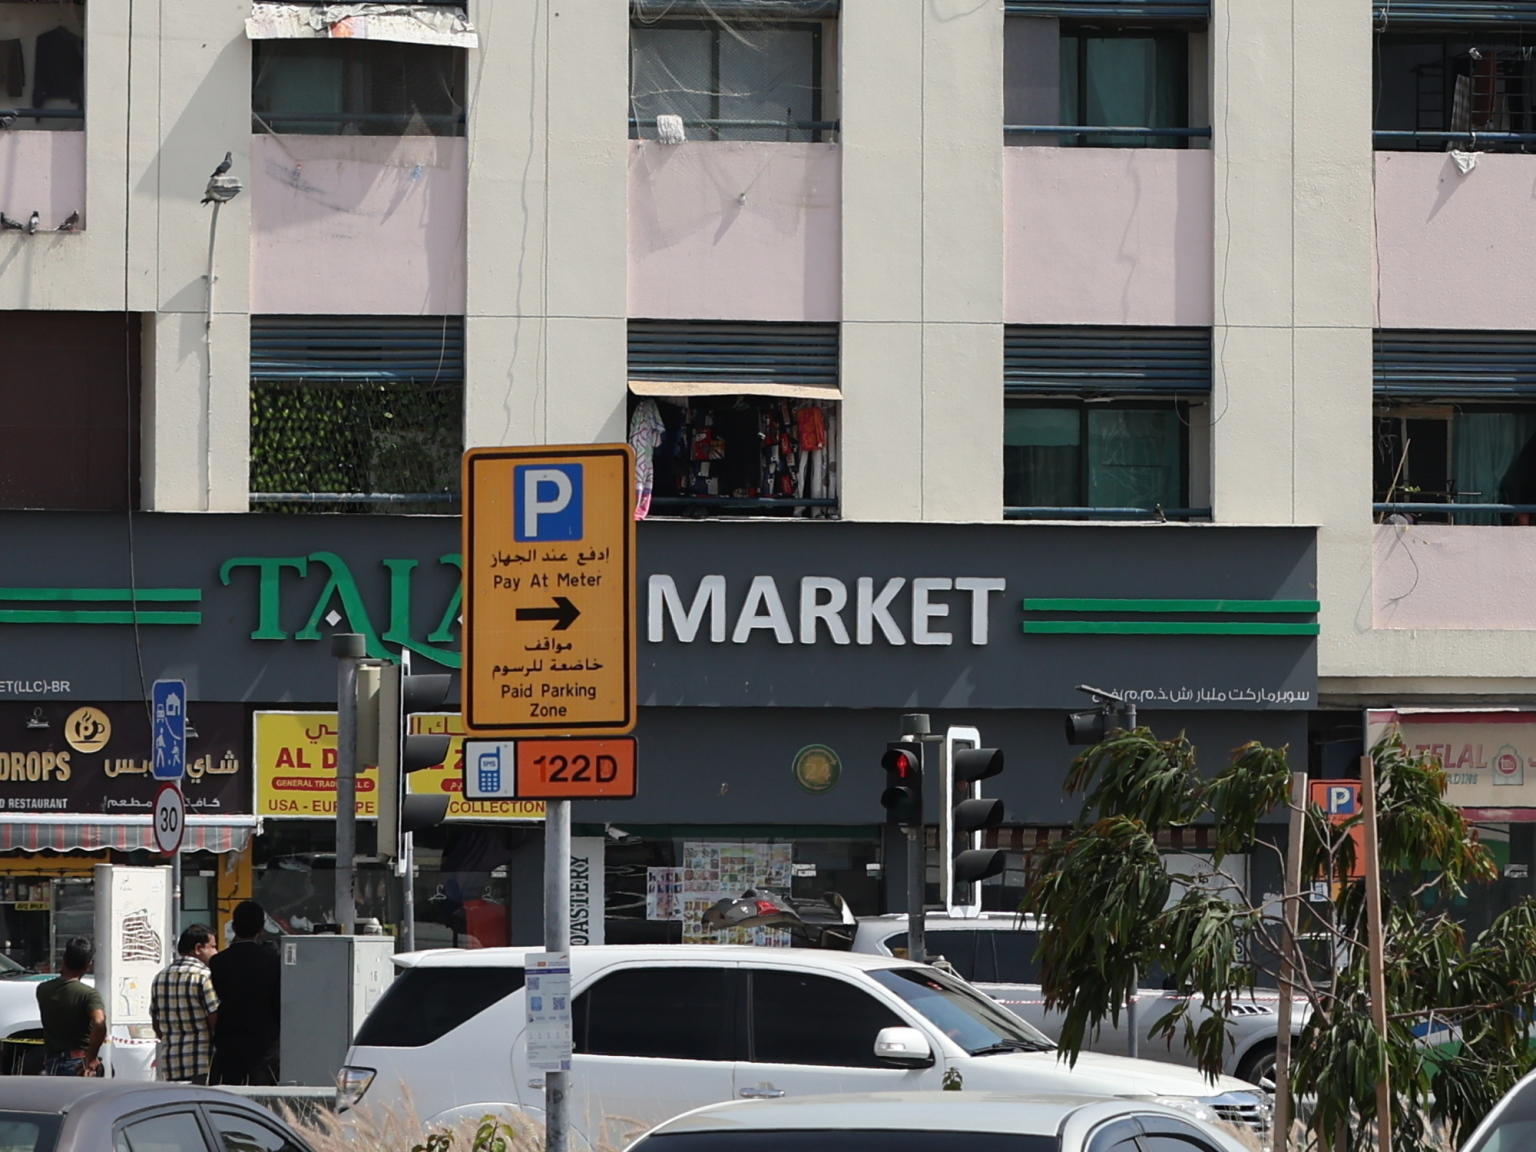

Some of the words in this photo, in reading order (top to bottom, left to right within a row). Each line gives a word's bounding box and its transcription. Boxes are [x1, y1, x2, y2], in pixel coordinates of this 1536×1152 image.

[524, 468, 573, 538] P
[489, 548, 537, 568] الجهاز
[541, 549, 568, 562] عند
[493, 575, 521, 591] Pay
[530, 574, 549, 588] At
[557, 572, 603, 587] Meter
[648, 574, 1006, 646] MARKET
[524, 636, 573, 654] مواقف
[492, 659, 543, 680] للرسوم
[549, 657, 604, 672] خاضعة
[501, 684, 533, 698] Paid
[541, 682, 597, 700] Parking
[529, 703, 568, 717] Zone
[0, 750, 72, 782] DROPS
[185, 750, 240, 784] شاي
[275, 747, 311, 769] AL
[533, 754, 618, 783] 122D
[276, 779, 313, 788] GENERAL
[315, 779, 338, 789] TRAD
[8, 798, 68, 809] RESTAURANT
[268, 799, 299, 812] USA
[449, 800, 545, 814] COLLECTION
[1330, 787, 1351, 814] P
[160, 806, 178, 833] 30
[570, 855, 589, 946] OASTERY
